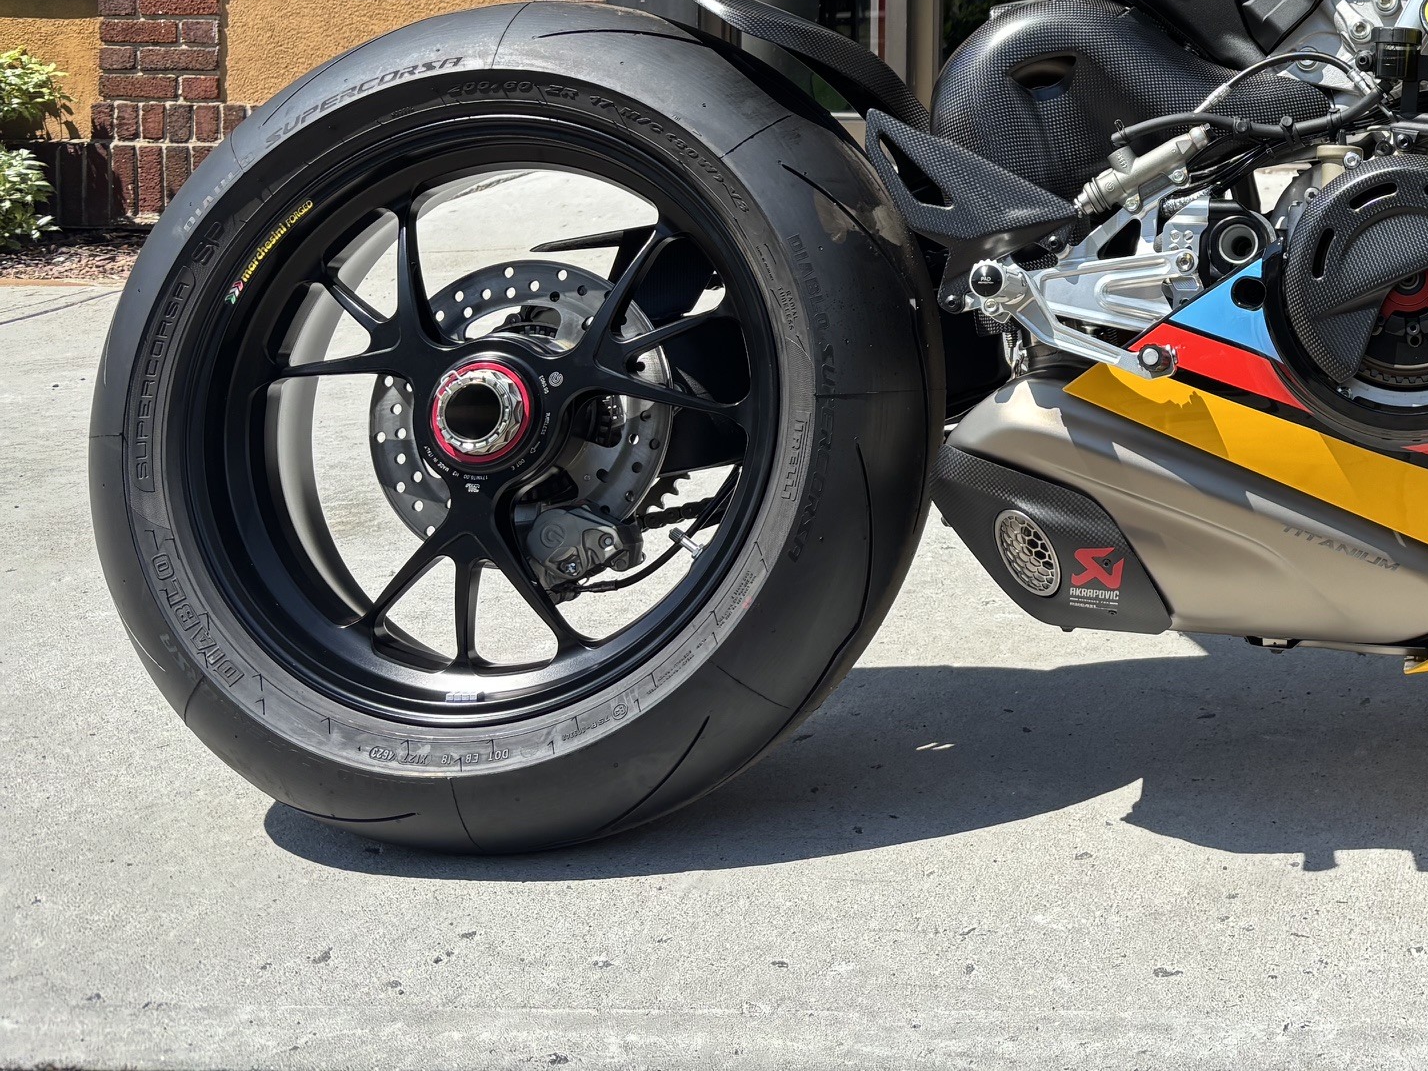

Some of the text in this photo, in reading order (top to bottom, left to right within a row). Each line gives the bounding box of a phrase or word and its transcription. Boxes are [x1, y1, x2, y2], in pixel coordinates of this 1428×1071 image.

[264, 56, 463, 149] SUPERCORSA
[135, 281, 190, 480] SUPERCORSA
[1281, 522, 1400, 571] TITANIUM
[152, 552, 245, 687] DIABLO
